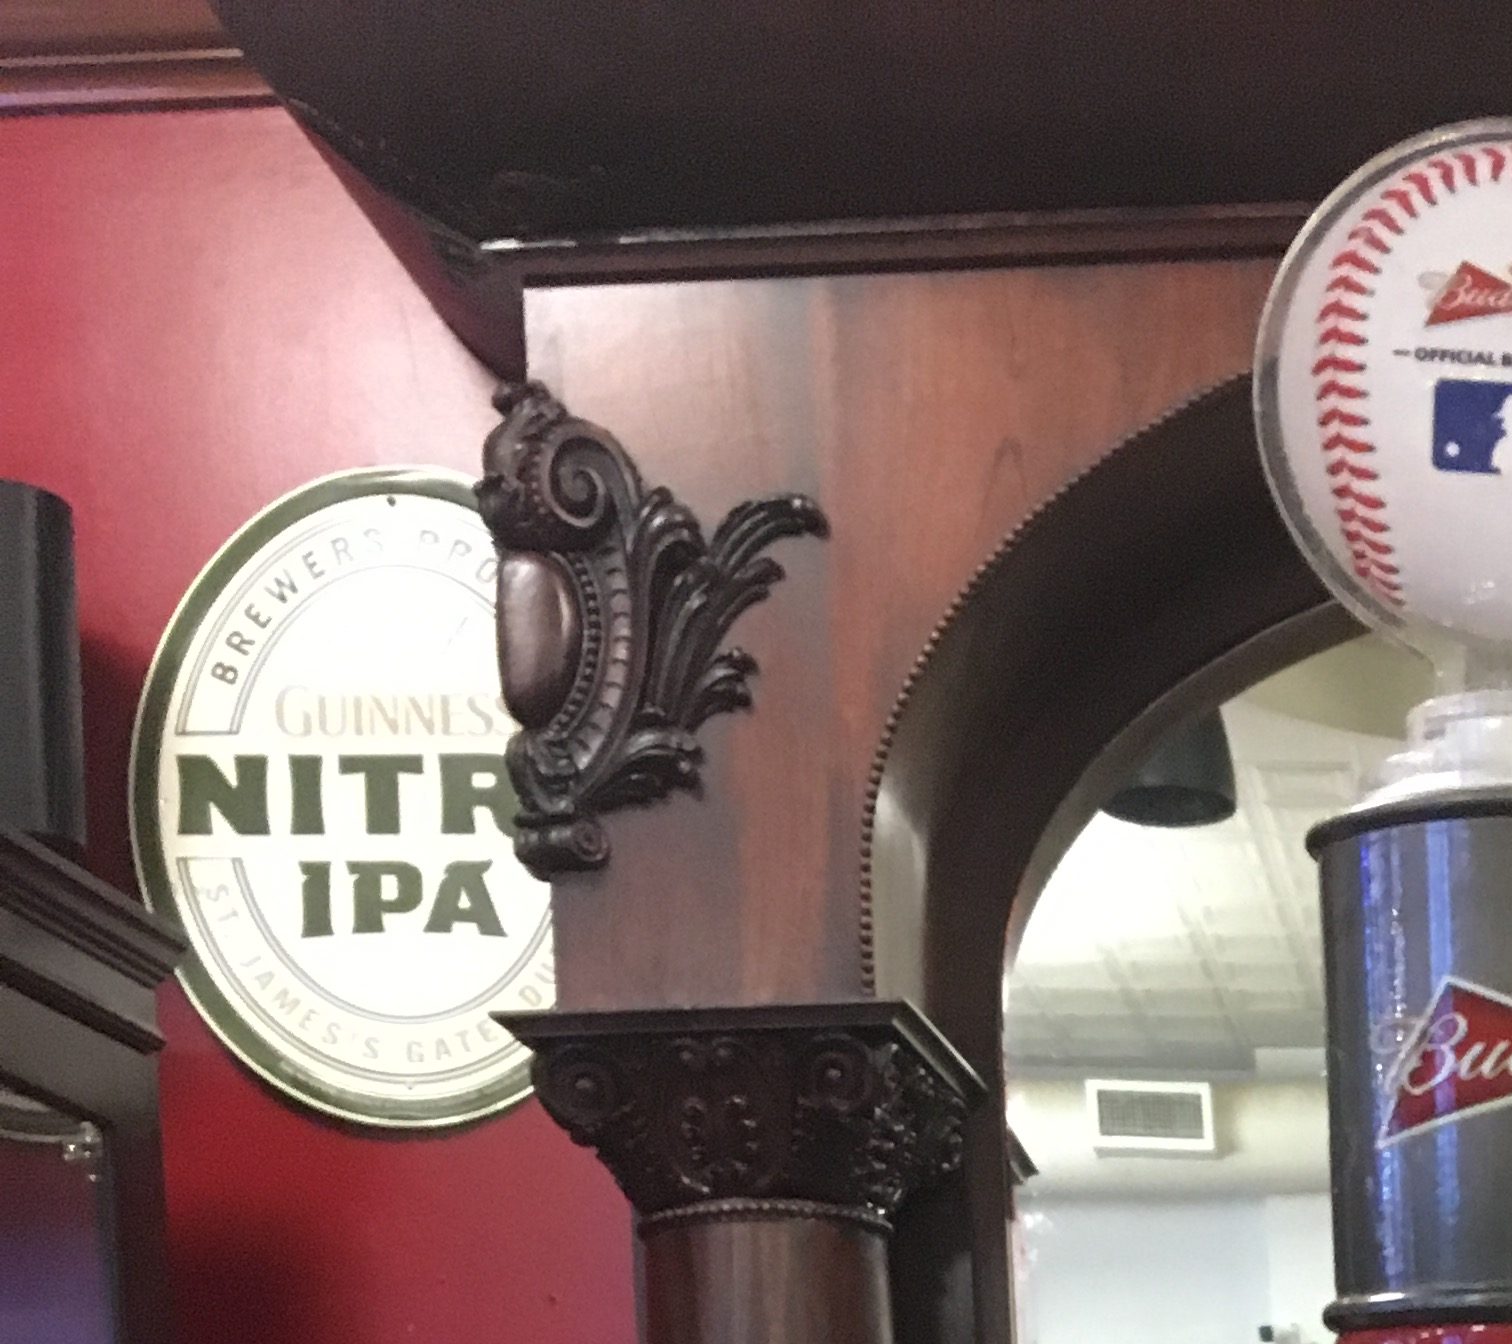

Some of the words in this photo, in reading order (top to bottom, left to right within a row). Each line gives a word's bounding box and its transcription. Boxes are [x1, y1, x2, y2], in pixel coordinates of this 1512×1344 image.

[1413, 346, 1496, 366] OFFICIAL
[209, 527, 386, 686] BREWERS
[176, 752, 516, 837] NITR
[298, 858, 509, 938] IPA
[405, 1018, 499, 1064] GATE
